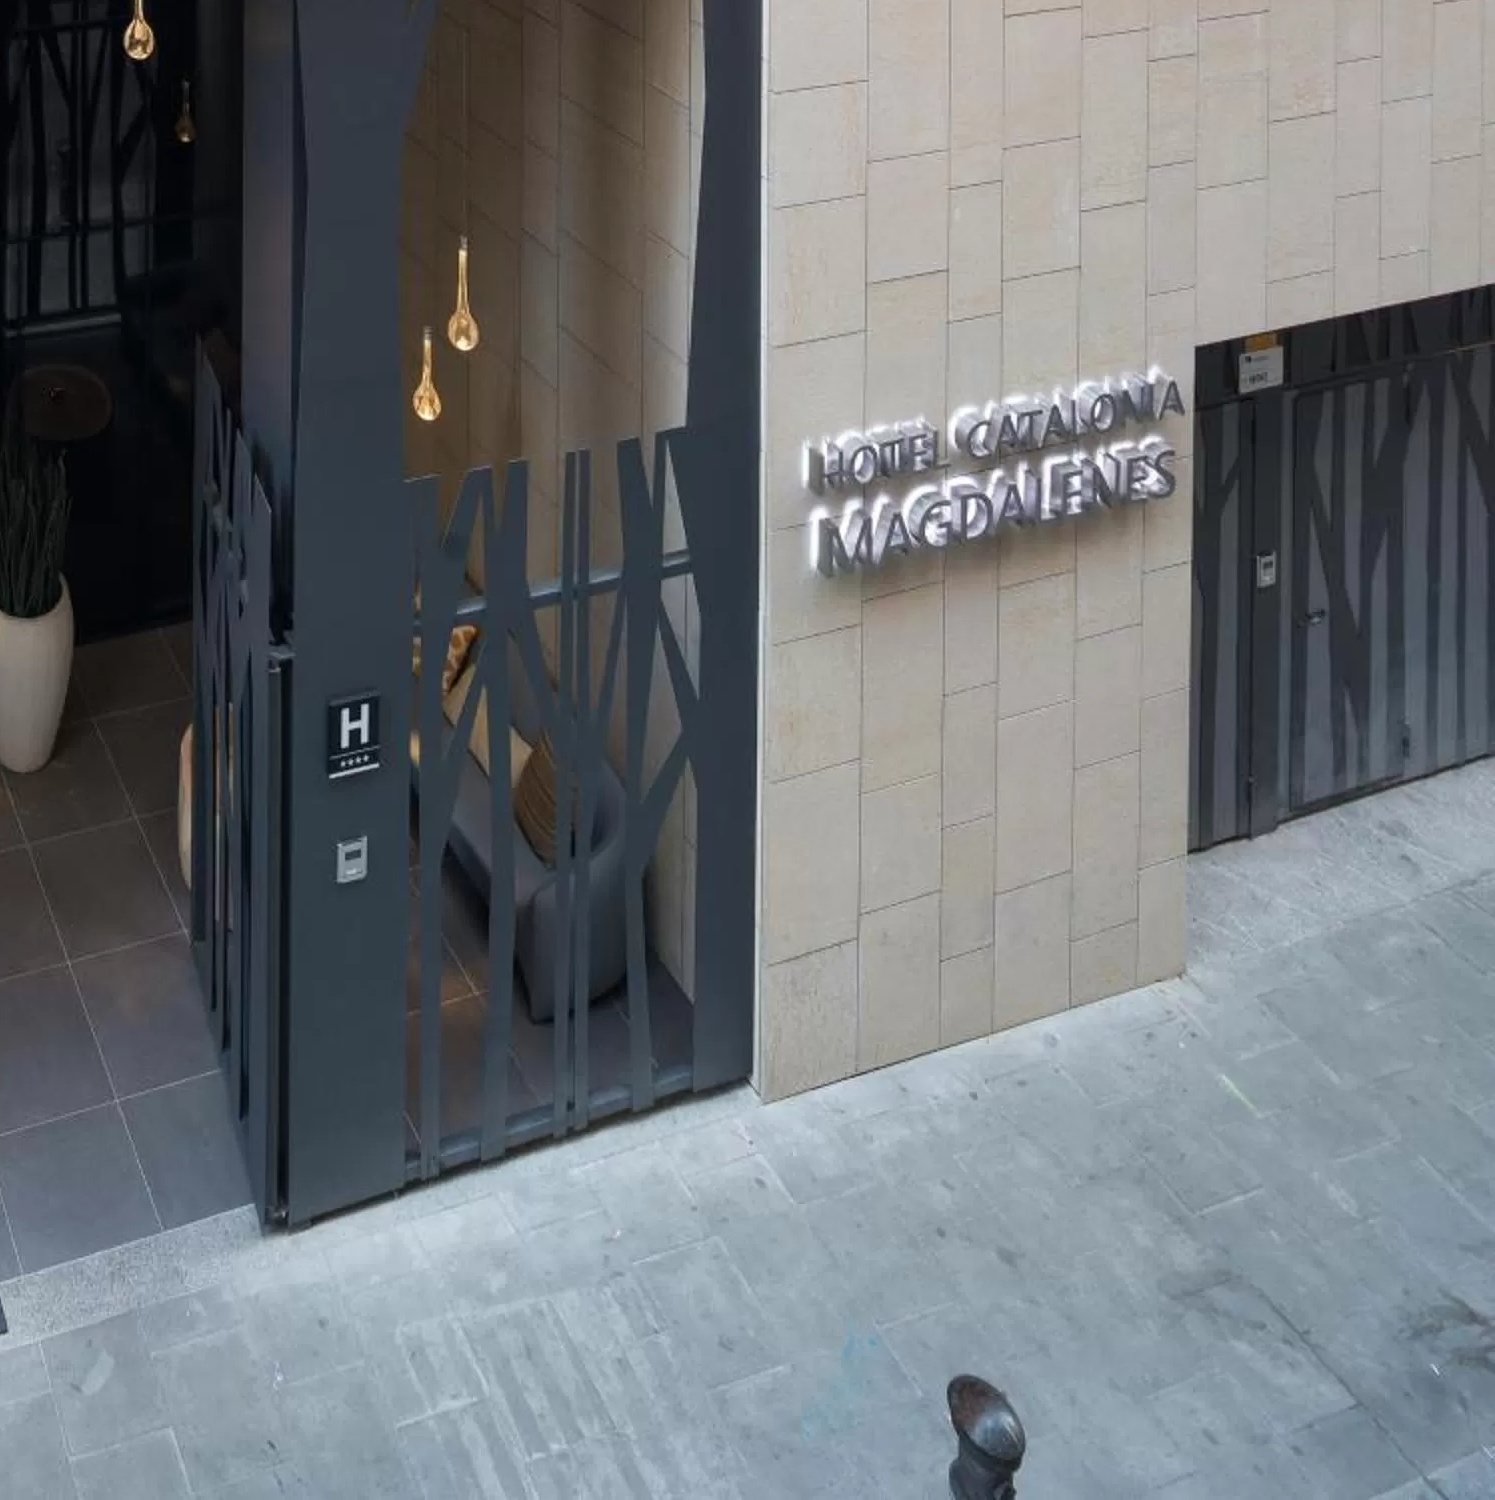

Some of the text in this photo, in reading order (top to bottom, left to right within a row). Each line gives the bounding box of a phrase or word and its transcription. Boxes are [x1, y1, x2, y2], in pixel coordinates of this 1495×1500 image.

[805, 418, 949, 494] HOTEL
[954, 368, 1186, 458] CATALONIA
[811, 438, 1177, 577] MAGDALENES
[340, 703, 370, 749] H
